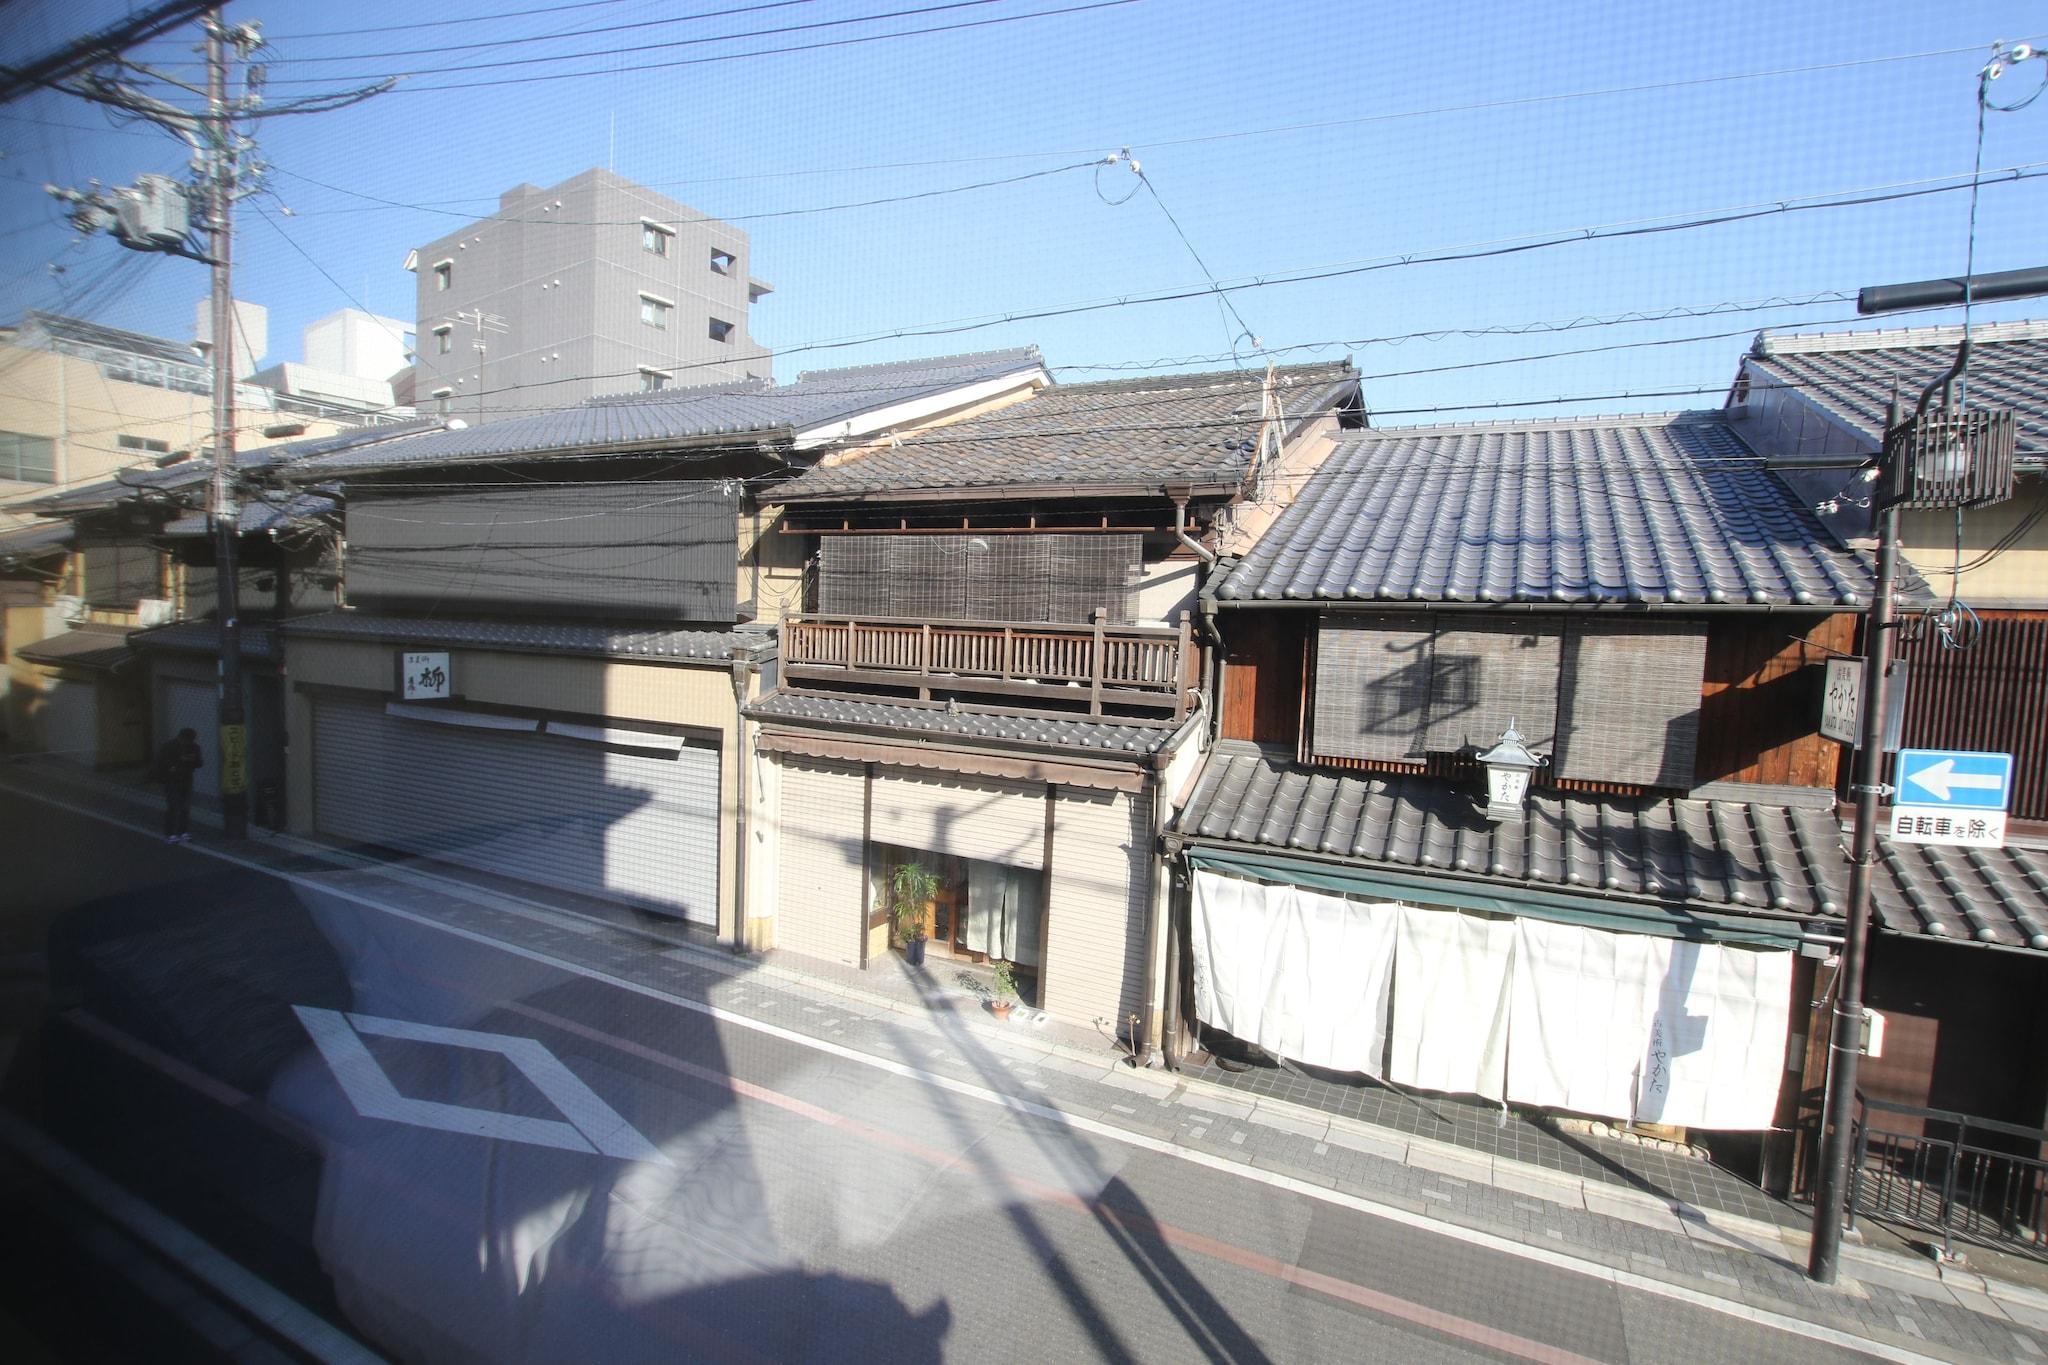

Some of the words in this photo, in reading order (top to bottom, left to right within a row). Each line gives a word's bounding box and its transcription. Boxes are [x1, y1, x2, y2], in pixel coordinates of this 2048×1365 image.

[1829, 682, 1855, 718] やかた
[1897, 815, 1999, 839] 自転車を除く
[1650, 1050, 1667, 1094] やかた
